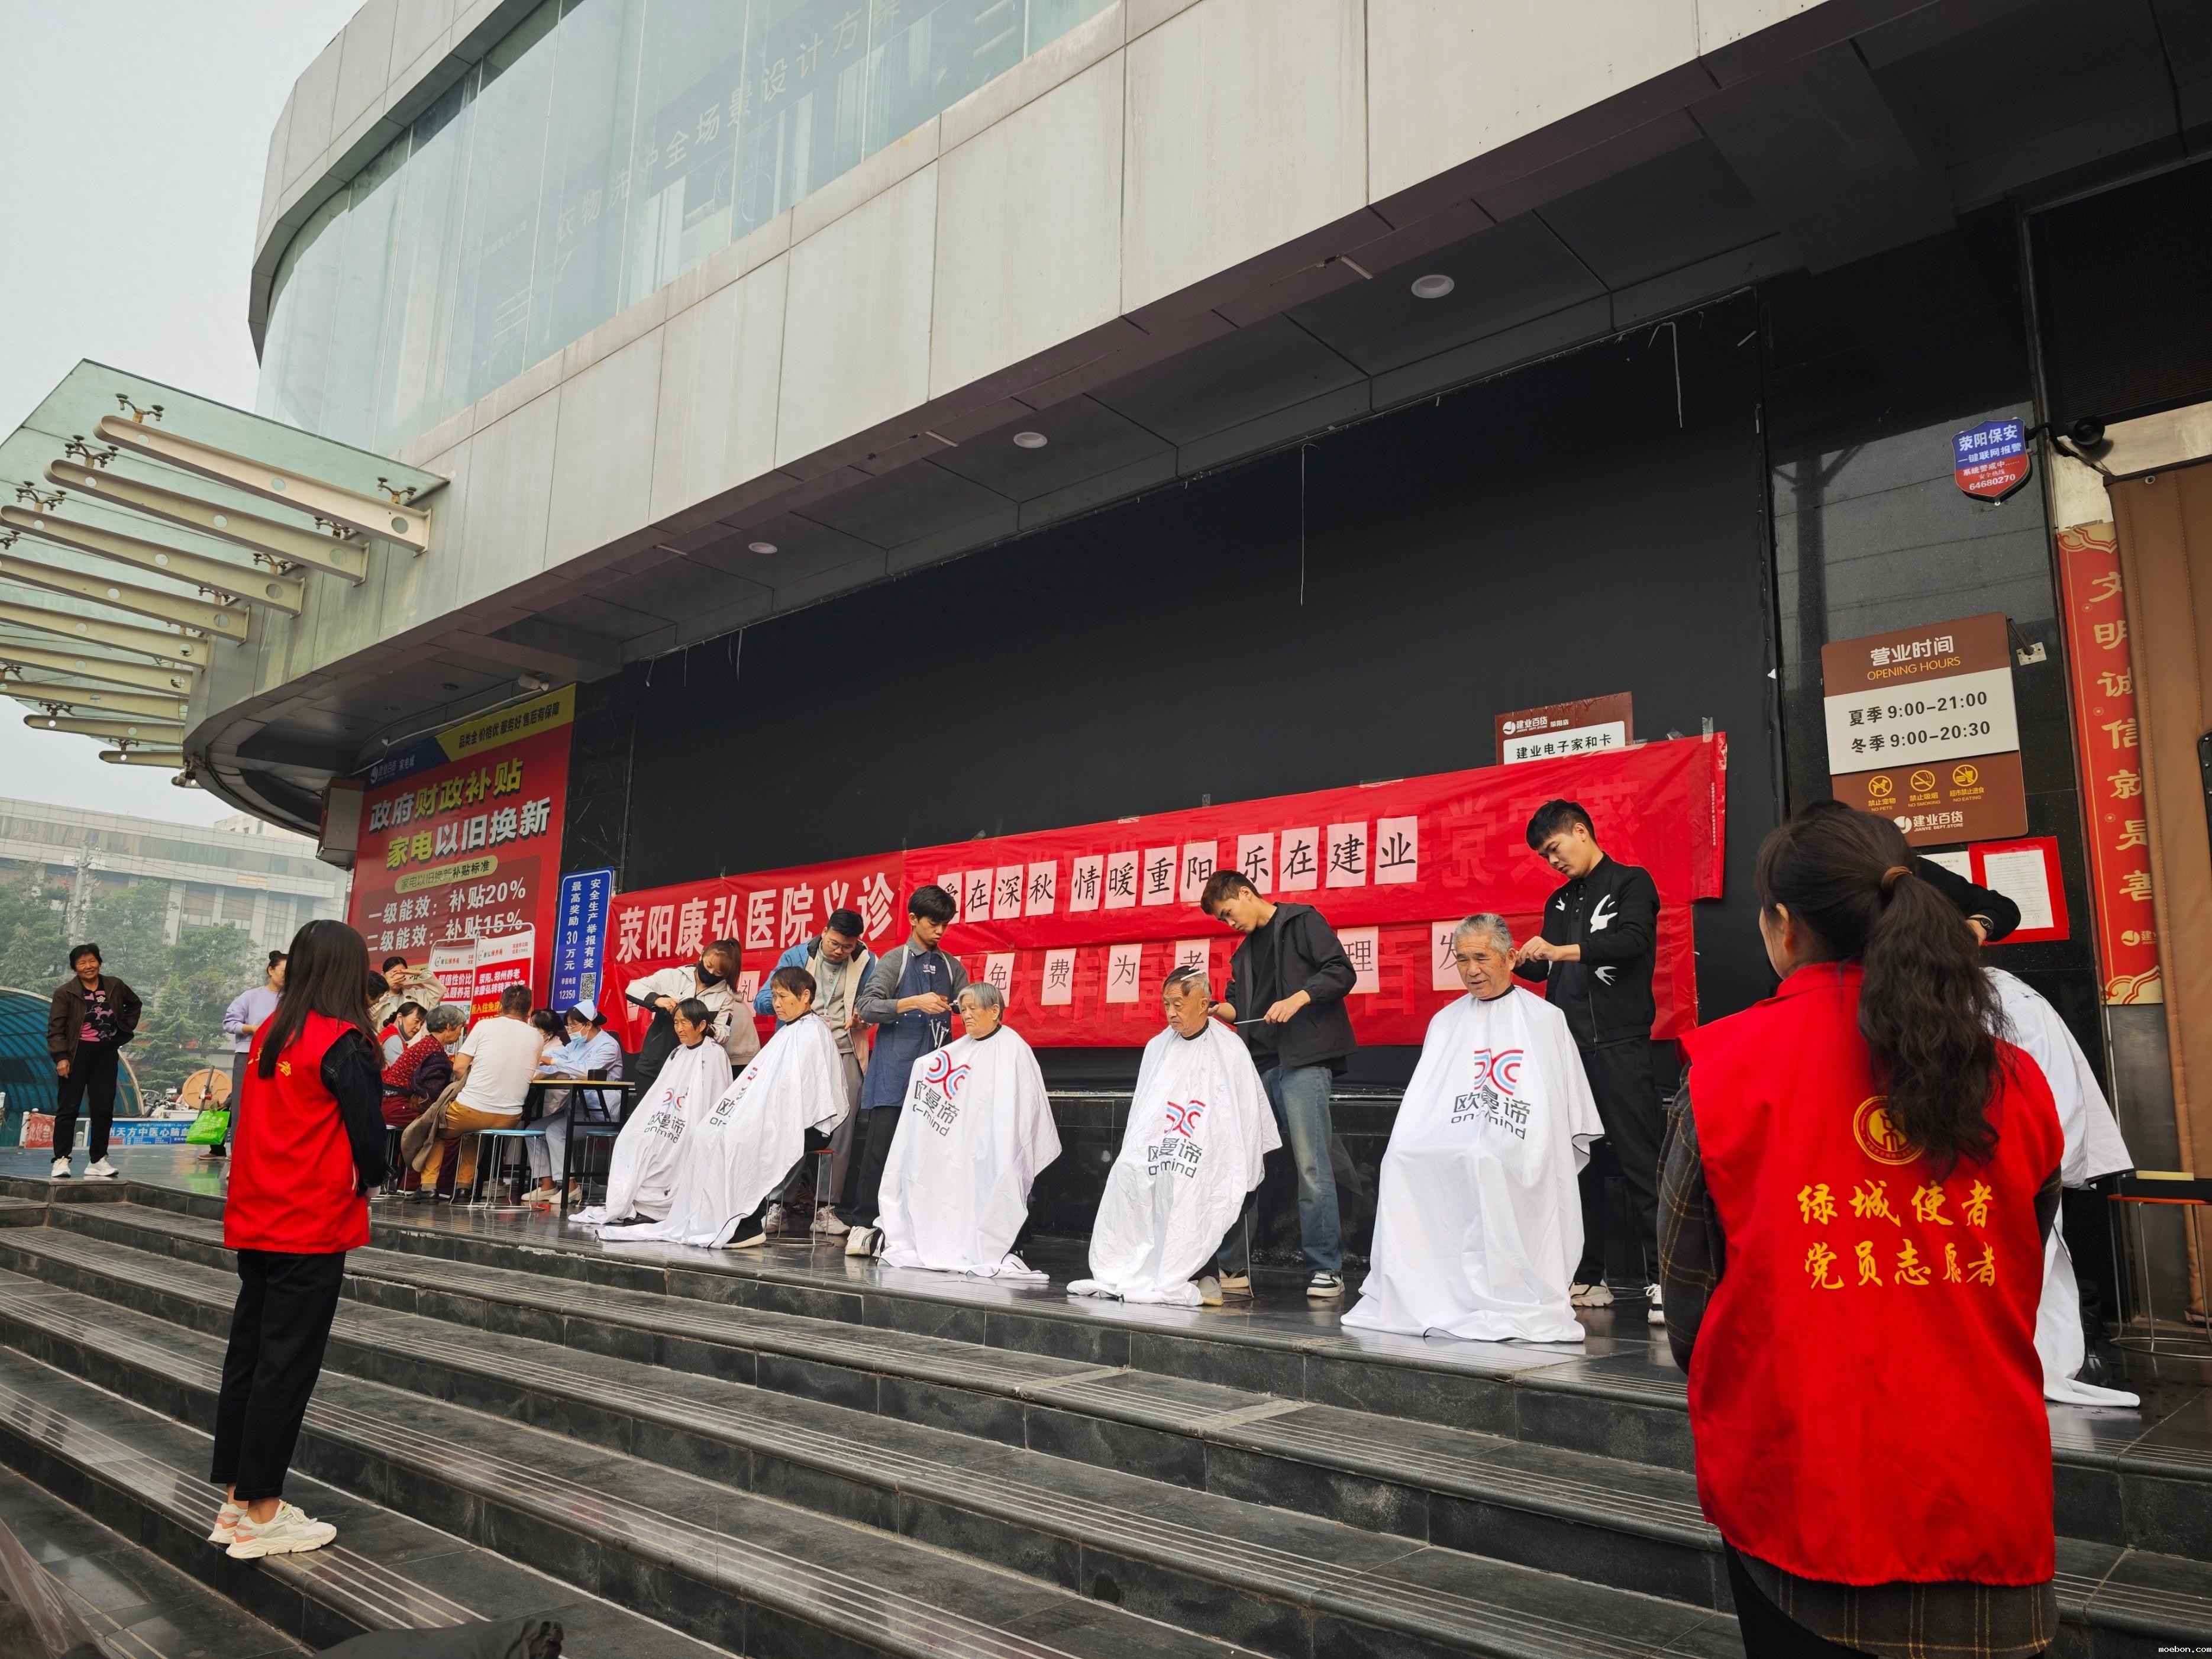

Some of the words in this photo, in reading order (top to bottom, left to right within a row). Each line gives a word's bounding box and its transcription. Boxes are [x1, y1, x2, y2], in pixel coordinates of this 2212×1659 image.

[1958, 424, 2018, 451] 荥阳保安
[1958, 443, 2022, 463] 一键联网报警
[1969, 474, 2016, 490] 64680270
[1870, 635, 1954, 667] 营业时间
[1867, 663, 1917, 681] OPENING
[1920, 656, 1961, 672] HOURS
[479, 725, 499, 741] 价格优
[500, 715, 522, 734] 服务好
[523, 701, 560, 727] 售后有保障
[1516, 715, 1548, 730] 建业百货
[1849, 706, 1882, 726] 夏季
[1516, 733, 1612, 760] 建业电子家和卡
[1851, 734, 1885, 754] 冬季
[369, 757, 524, 832] 政府财政补贴
[1868, 798, 1896, 807] 禁止宠物
[1909, 792, 1939, 802] 禁止吸烟
[1949, 787, 1985, 798] 超市禁止进食
[386, 796, 551, 869] 家电以旧换新
[1913, 811, 1964, 828] 建业百货
[401, 860, 490, 890] 家电以旧换新补贴标准
[1074, 856, 1213, 901] 情暖重阳
[1244, 831, 1417, 884] 乐在建业
[448, 876, 526, 913] 补贴20%
[583, 879, 601, 969] 安全生产举报有奖
[616, 872, 895, 964] 荥阳康弘医院义诊
[559, 989, 576, 1000] 12350
[1797, 1179, 1994, 1229] 绿城使者
[1804, 1238, 1997, 1290] 党员志愿者
